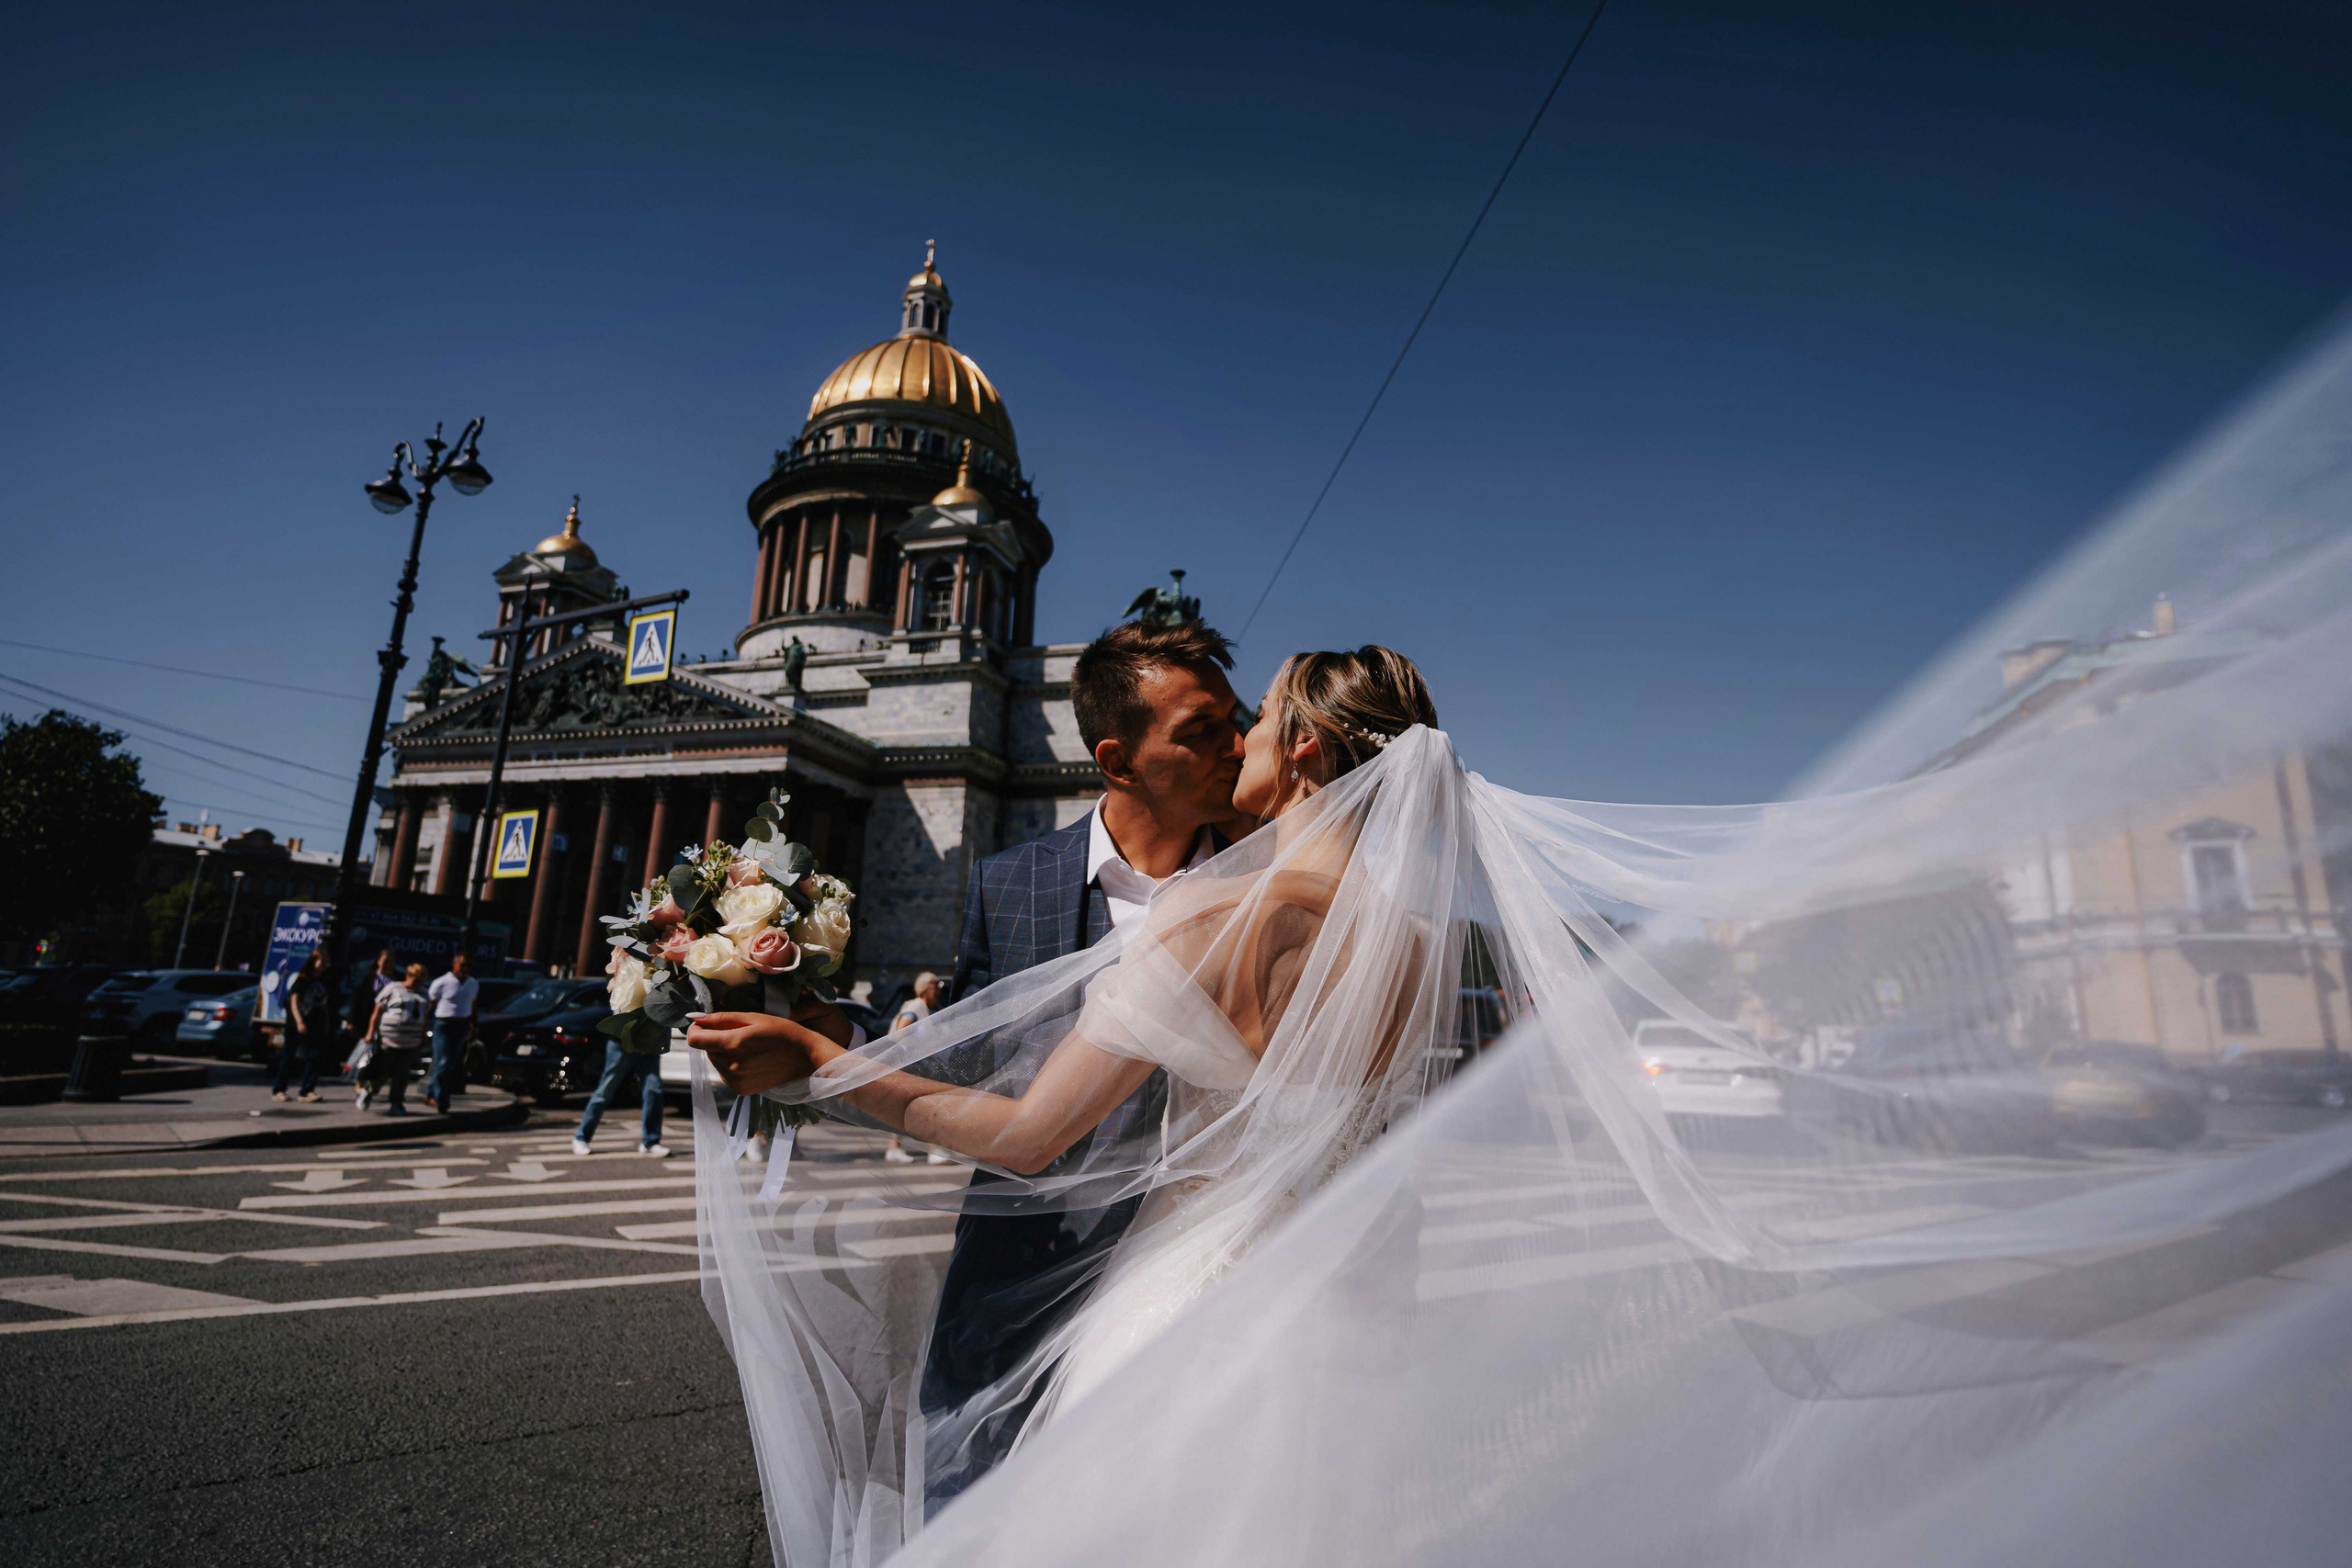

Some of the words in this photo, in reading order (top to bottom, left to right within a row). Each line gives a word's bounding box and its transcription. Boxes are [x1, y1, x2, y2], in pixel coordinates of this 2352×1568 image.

[273, 927, 324, 944] ЭКСКУРС
[389, 938, 447, 954] GUIDED
[451, 941, 497, 958] TURS
